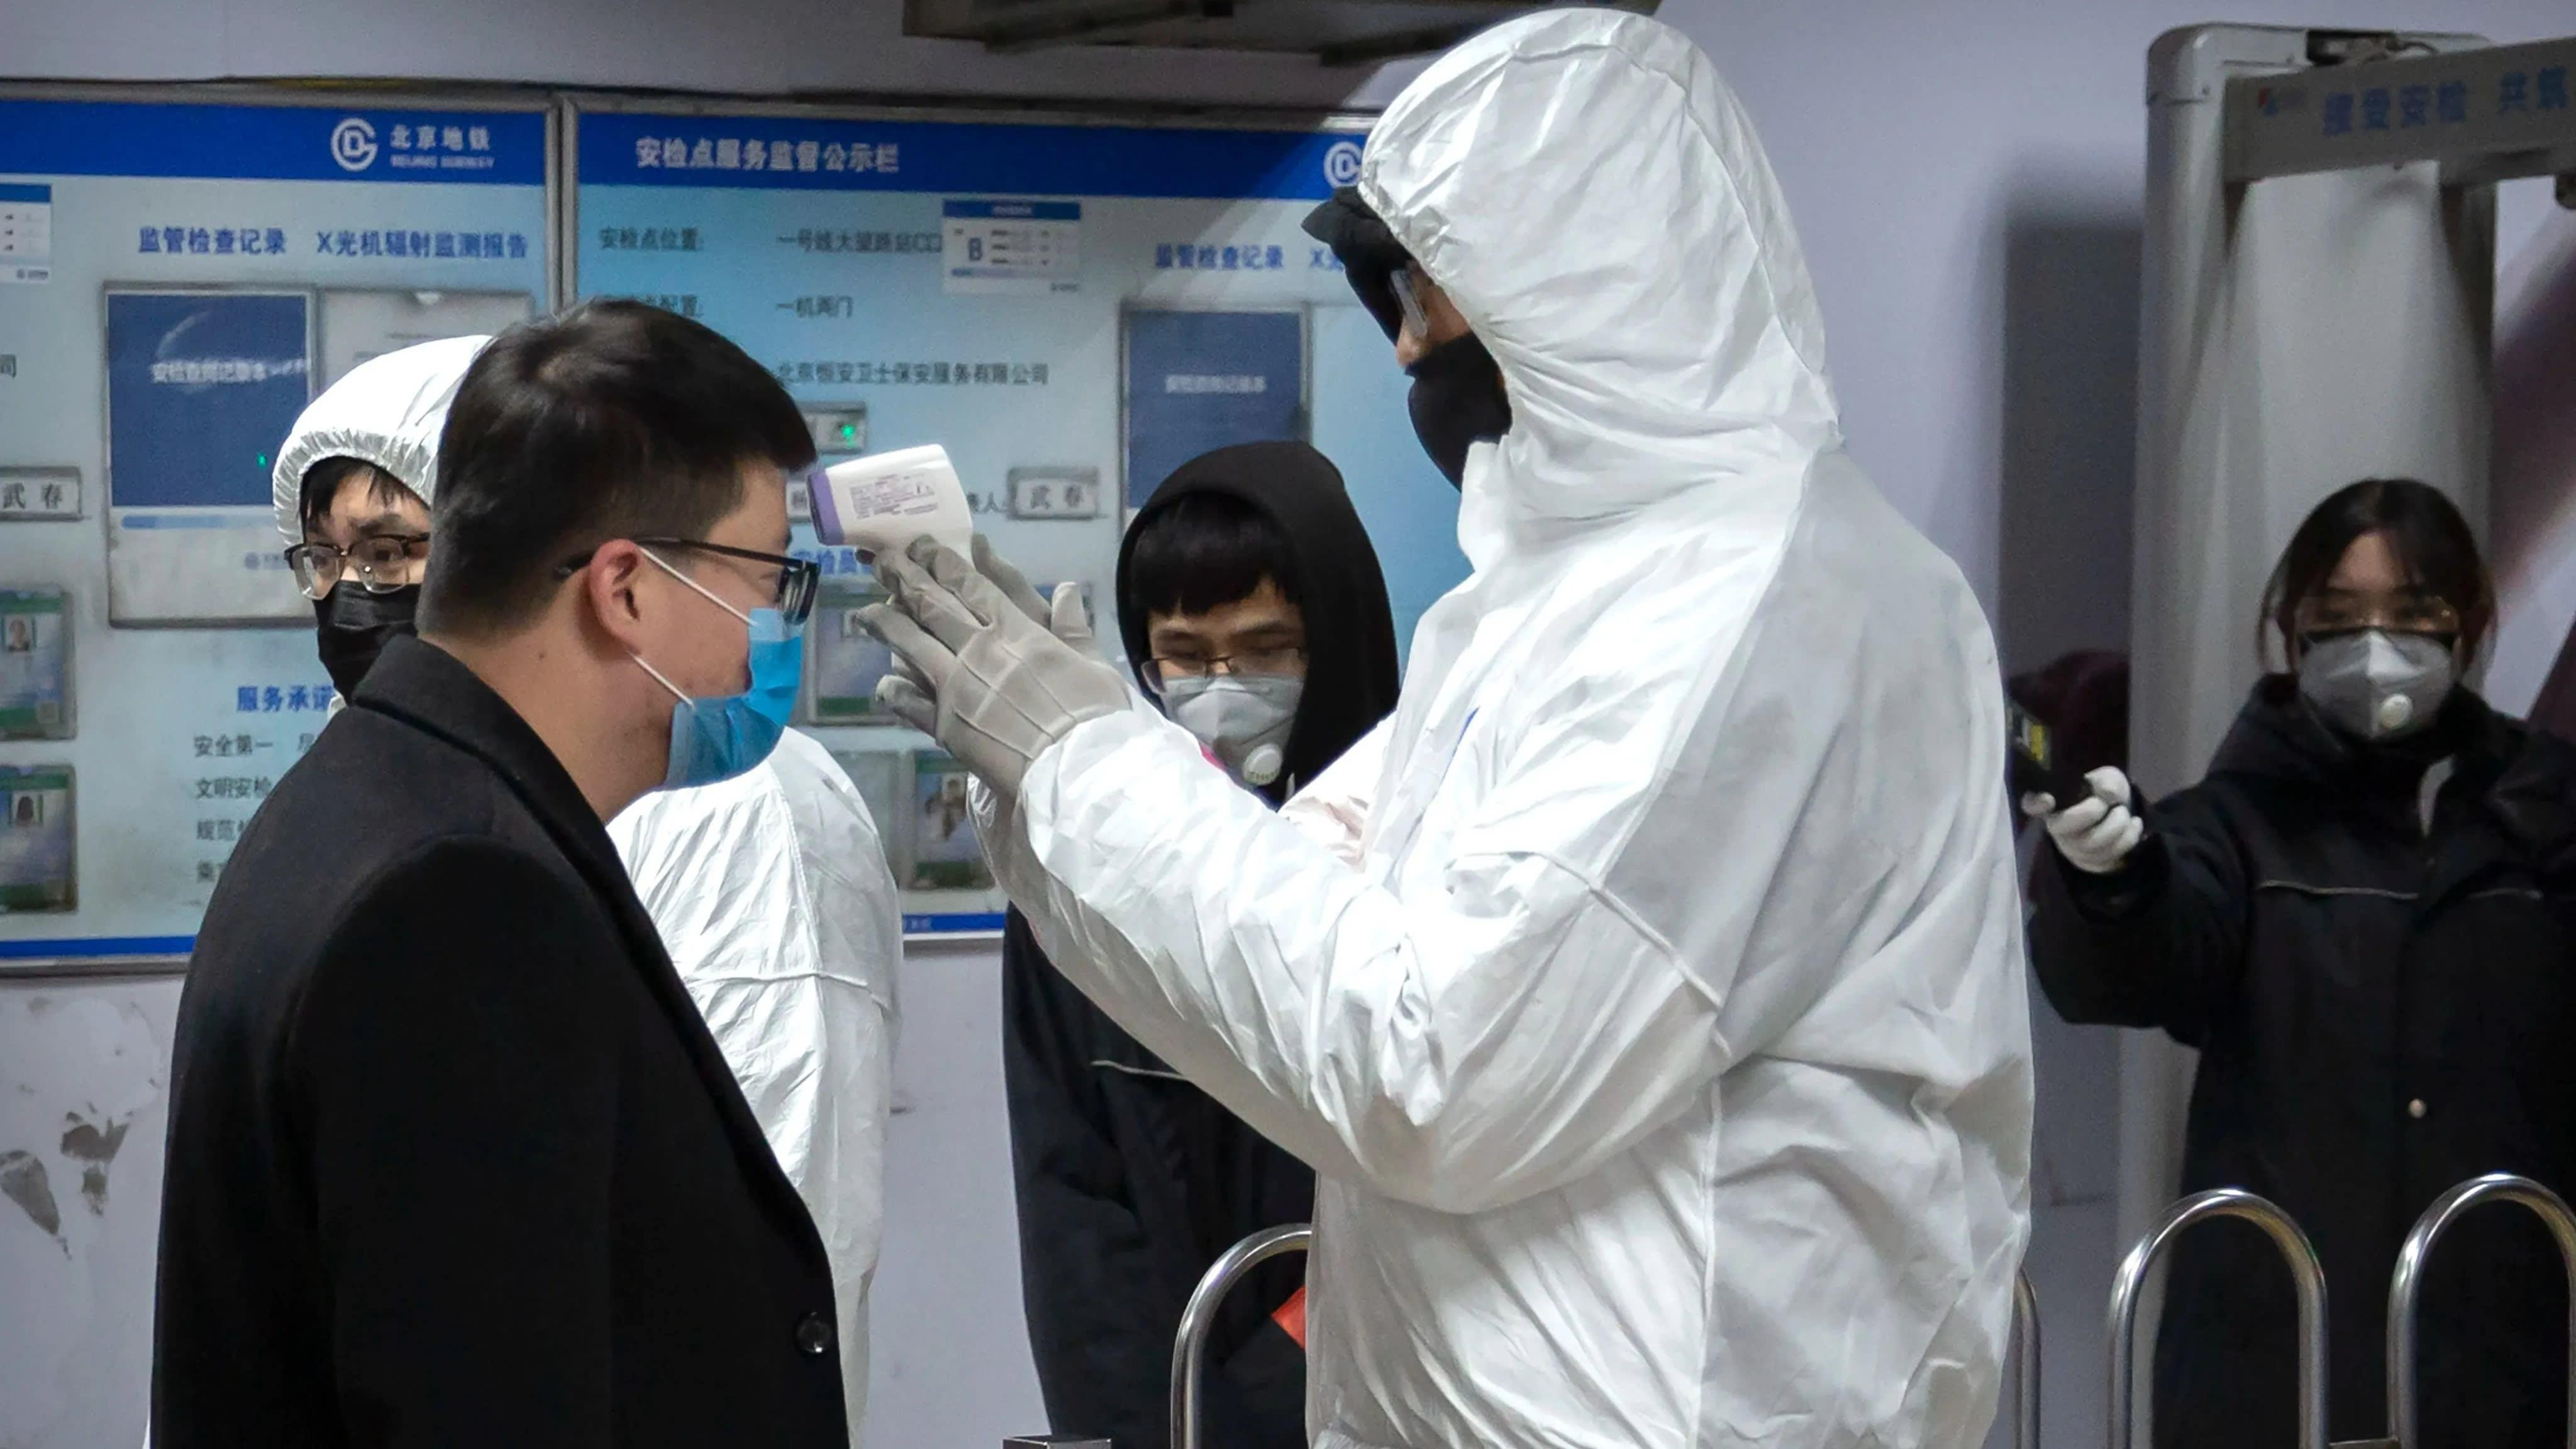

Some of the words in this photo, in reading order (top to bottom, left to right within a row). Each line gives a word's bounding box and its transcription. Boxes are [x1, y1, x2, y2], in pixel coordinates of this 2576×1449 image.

[390, 124, 491, 151] 北京地铁
[636, 136, 899, 173] 安检点服务监督公示栏
[138, 226, 287, 255] 监管检查记录
[316, 230, 528, 259] X光机辐射监测报告
[193, 733, 273, 758] 安全第一
